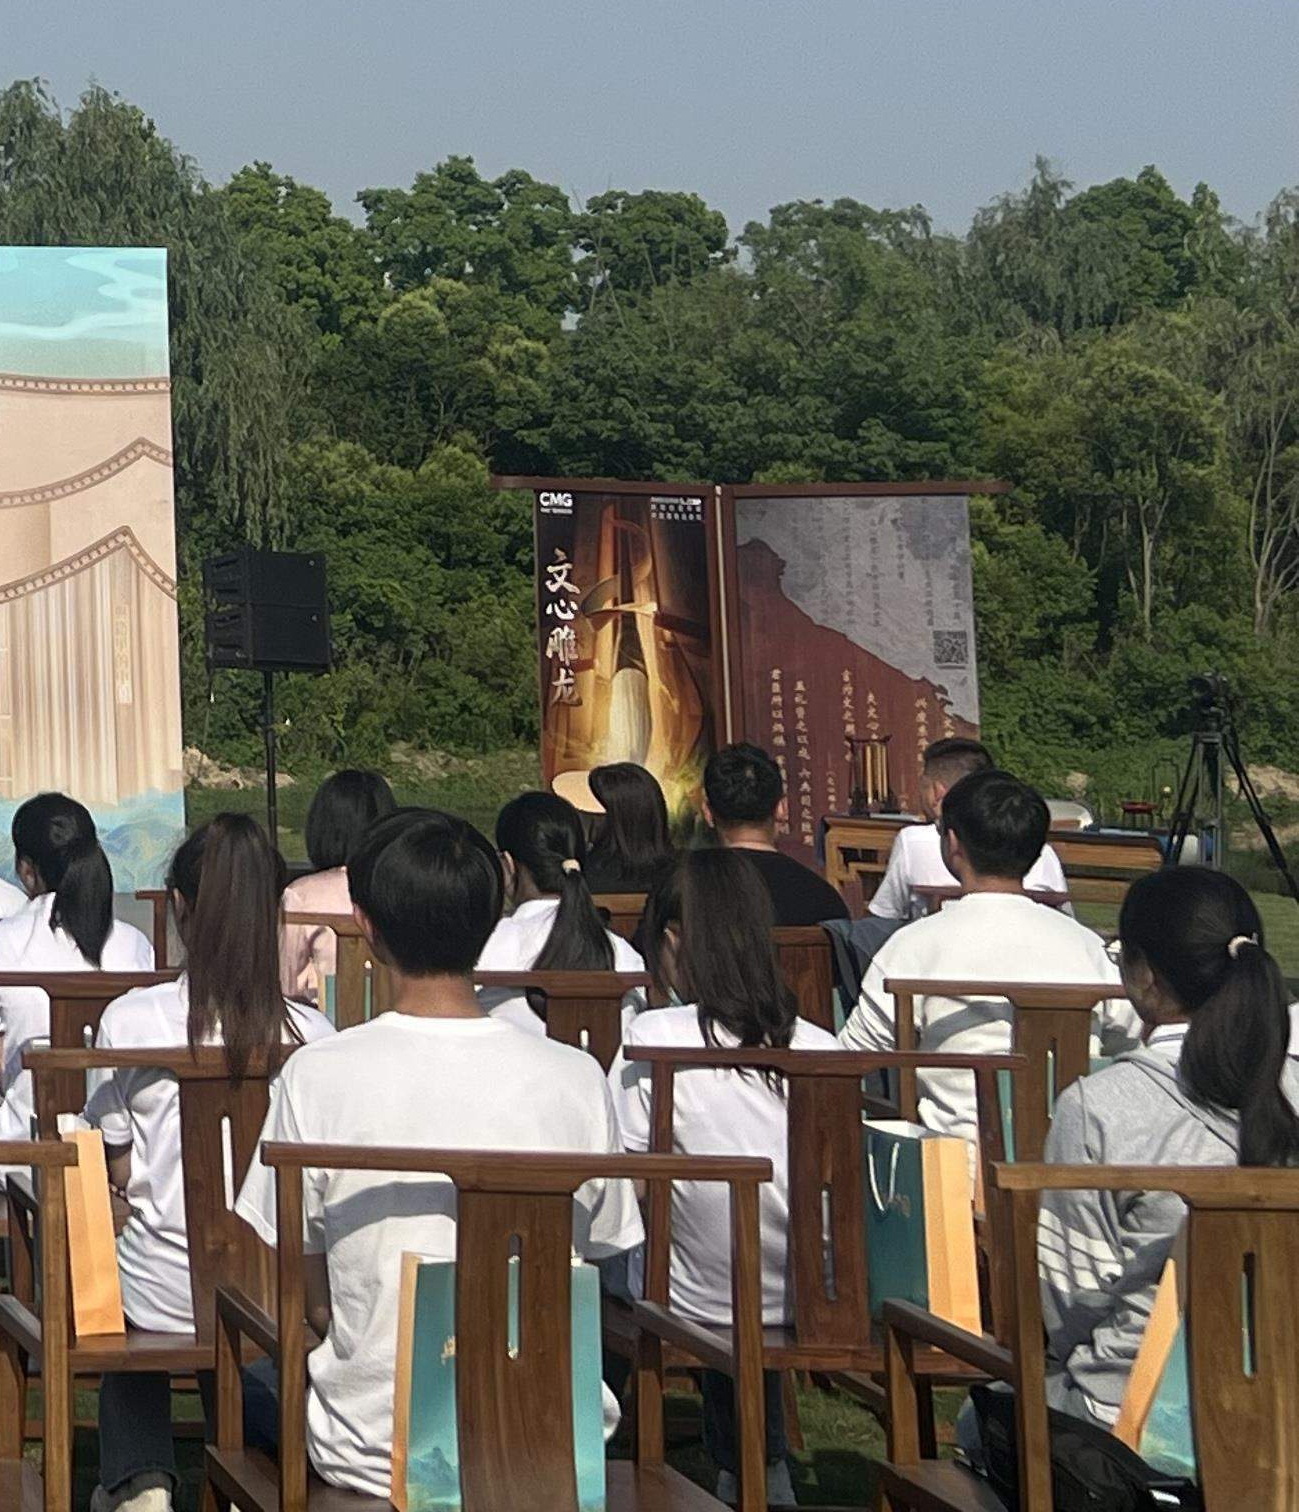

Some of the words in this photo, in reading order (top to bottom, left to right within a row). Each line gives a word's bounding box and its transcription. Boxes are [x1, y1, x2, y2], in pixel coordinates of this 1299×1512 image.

[539, 492, 573, 507] CMG
[544, 547, 583, 707] 文心雕龙
